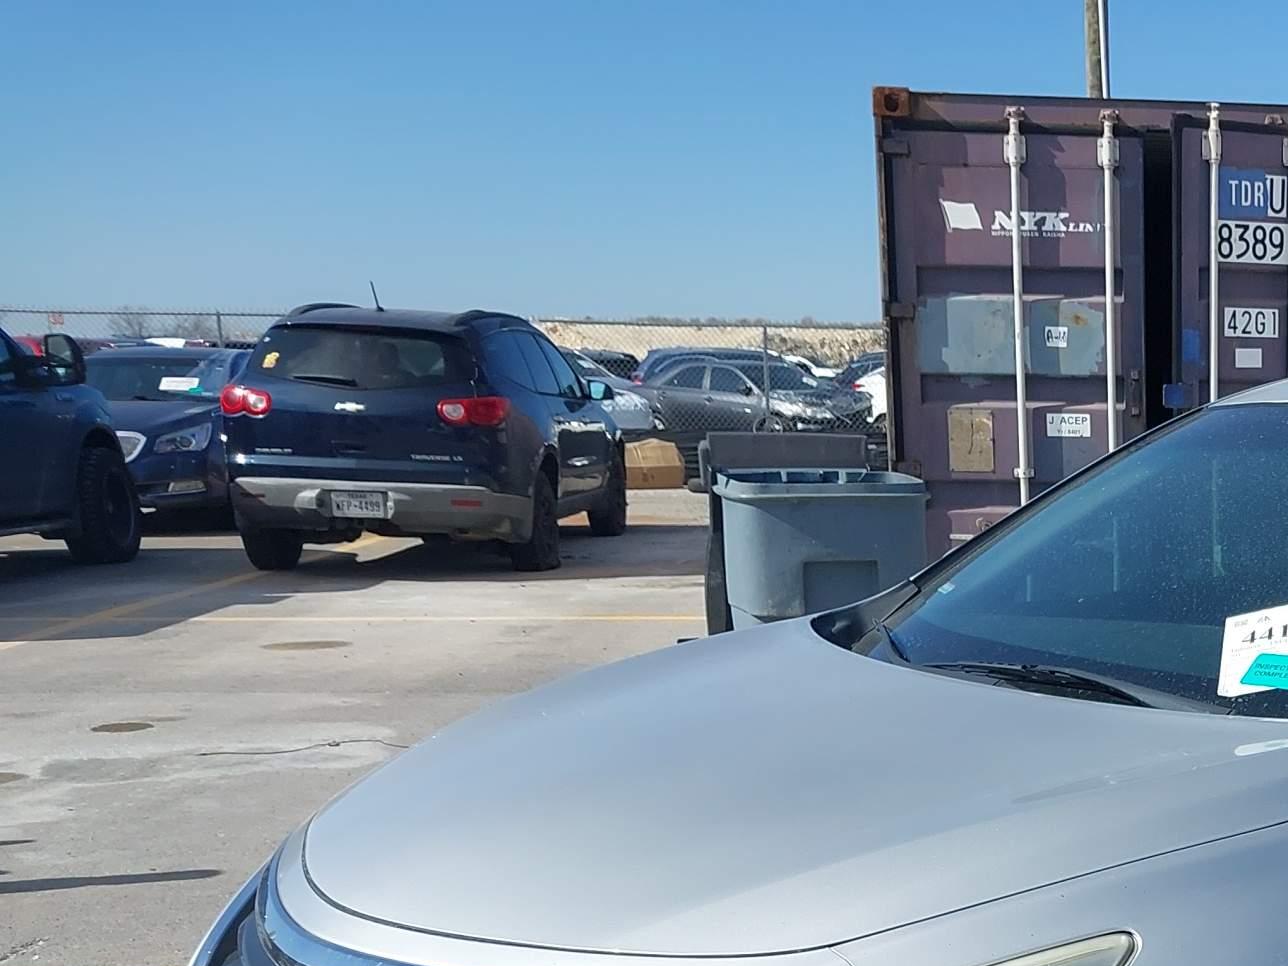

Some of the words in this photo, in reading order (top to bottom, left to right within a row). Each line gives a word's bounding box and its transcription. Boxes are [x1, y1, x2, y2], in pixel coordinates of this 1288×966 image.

[1228, 177, 1286, 214] TDRU
[991, 210, 1070, 232] NYK
[1227, 309, 1276, 335] 42G1
[1059, 416, 1088, 425] ACEP
